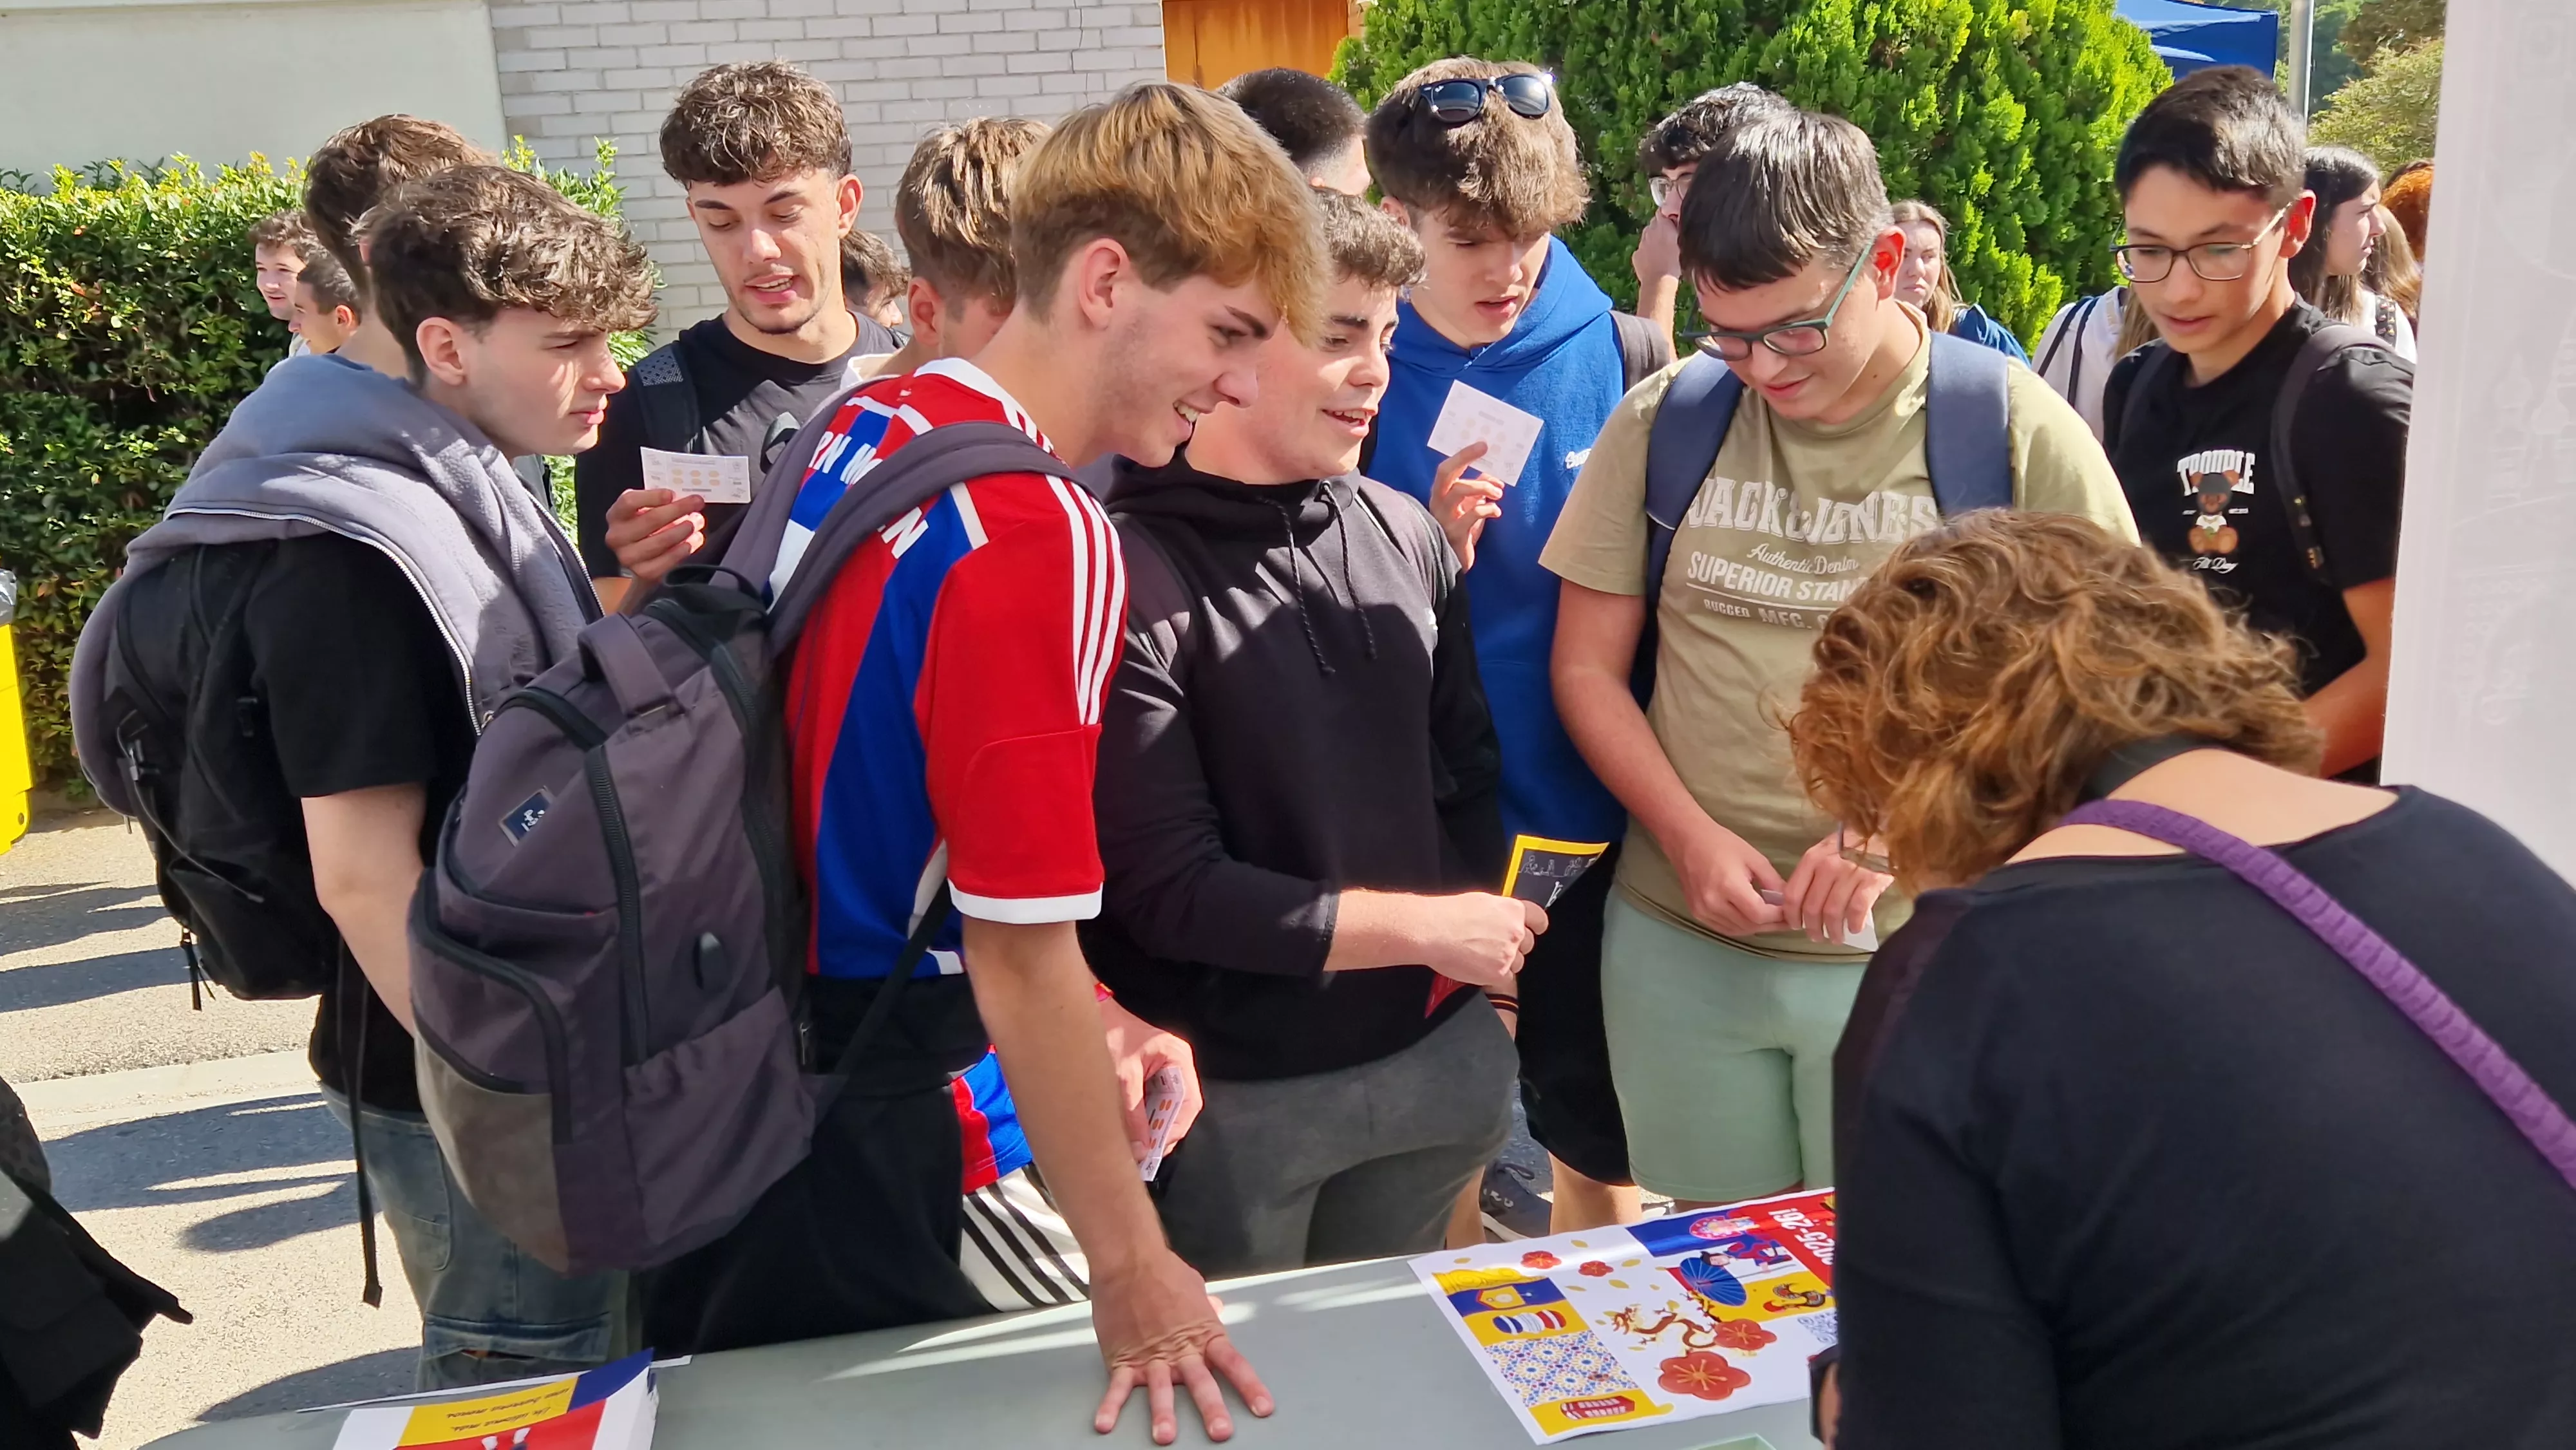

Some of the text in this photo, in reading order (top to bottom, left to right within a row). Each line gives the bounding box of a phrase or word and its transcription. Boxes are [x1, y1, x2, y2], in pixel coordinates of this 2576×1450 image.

[1747, 543, 1859, 574] Authentic Denim
[2212, 558, 2239, 574] Day
[1687, 551, 1868, 601] SUPERIOR STAN
[1703, 599, 1750, 617] RUGGED
[1758, 608, 1812, 630] MFG.
